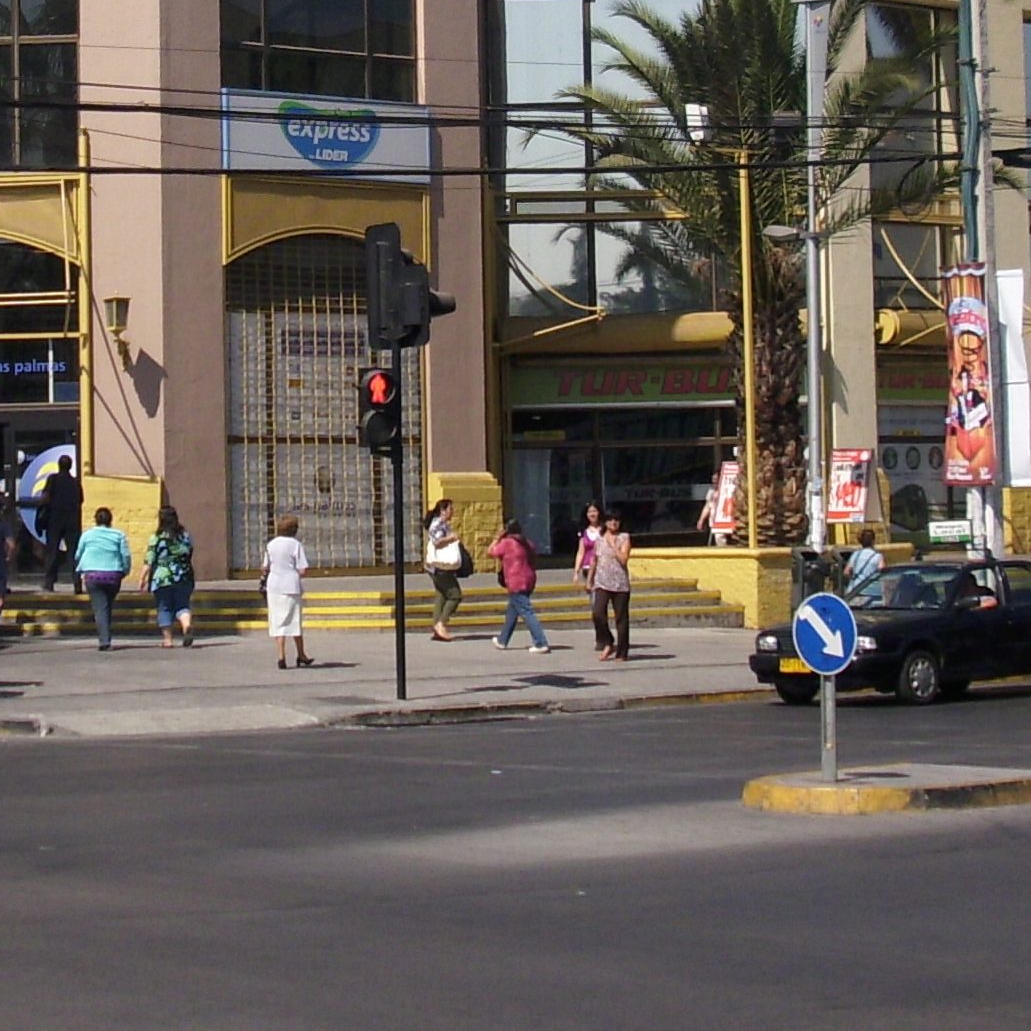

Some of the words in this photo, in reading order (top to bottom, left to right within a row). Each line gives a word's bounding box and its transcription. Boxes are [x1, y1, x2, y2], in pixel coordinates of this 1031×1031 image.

[288, 120, 371, 144] express
[315, 149, 348, 162] LIDER
[14, 359, 66, 378] palmas
[557, 369, 736, 397] TUR-BU
